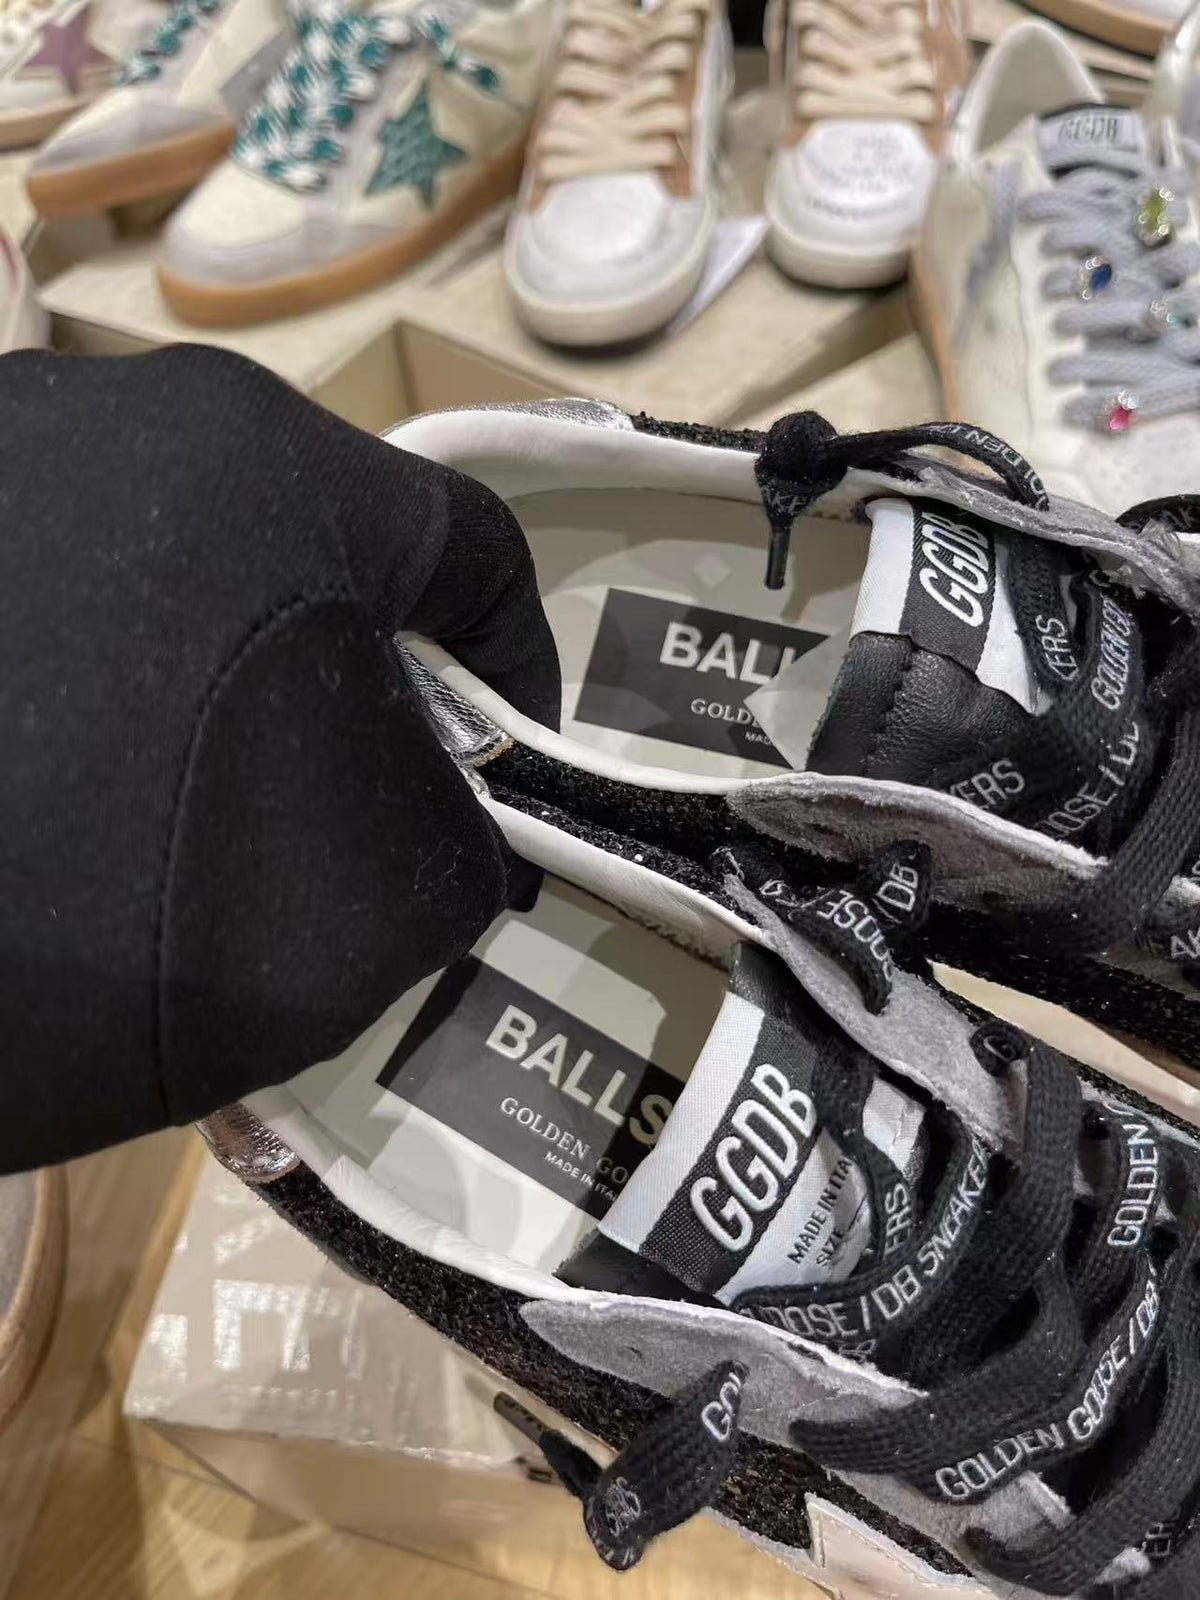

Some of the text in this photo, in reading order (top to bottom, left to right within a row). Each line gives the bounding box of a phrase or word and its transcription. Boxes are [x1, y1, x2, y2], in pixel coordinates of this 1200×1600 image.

[500, 1096, 591, 1161] GOLDEN
[544, 1150, 581, 1179] MADE
[690, 1063, 817, 1251] GGDB
[1106, 1123, 1159, 1247] GOLDEN
[787, 1208, 828, 1265] MADE
[817, 1187, 839, 1214] IN
[871, 1264, 922, 1321] DB
[935, 1422, 1065, 1500] GOLDEN
[1066, 1334, 1127, 1440] GOOSE
